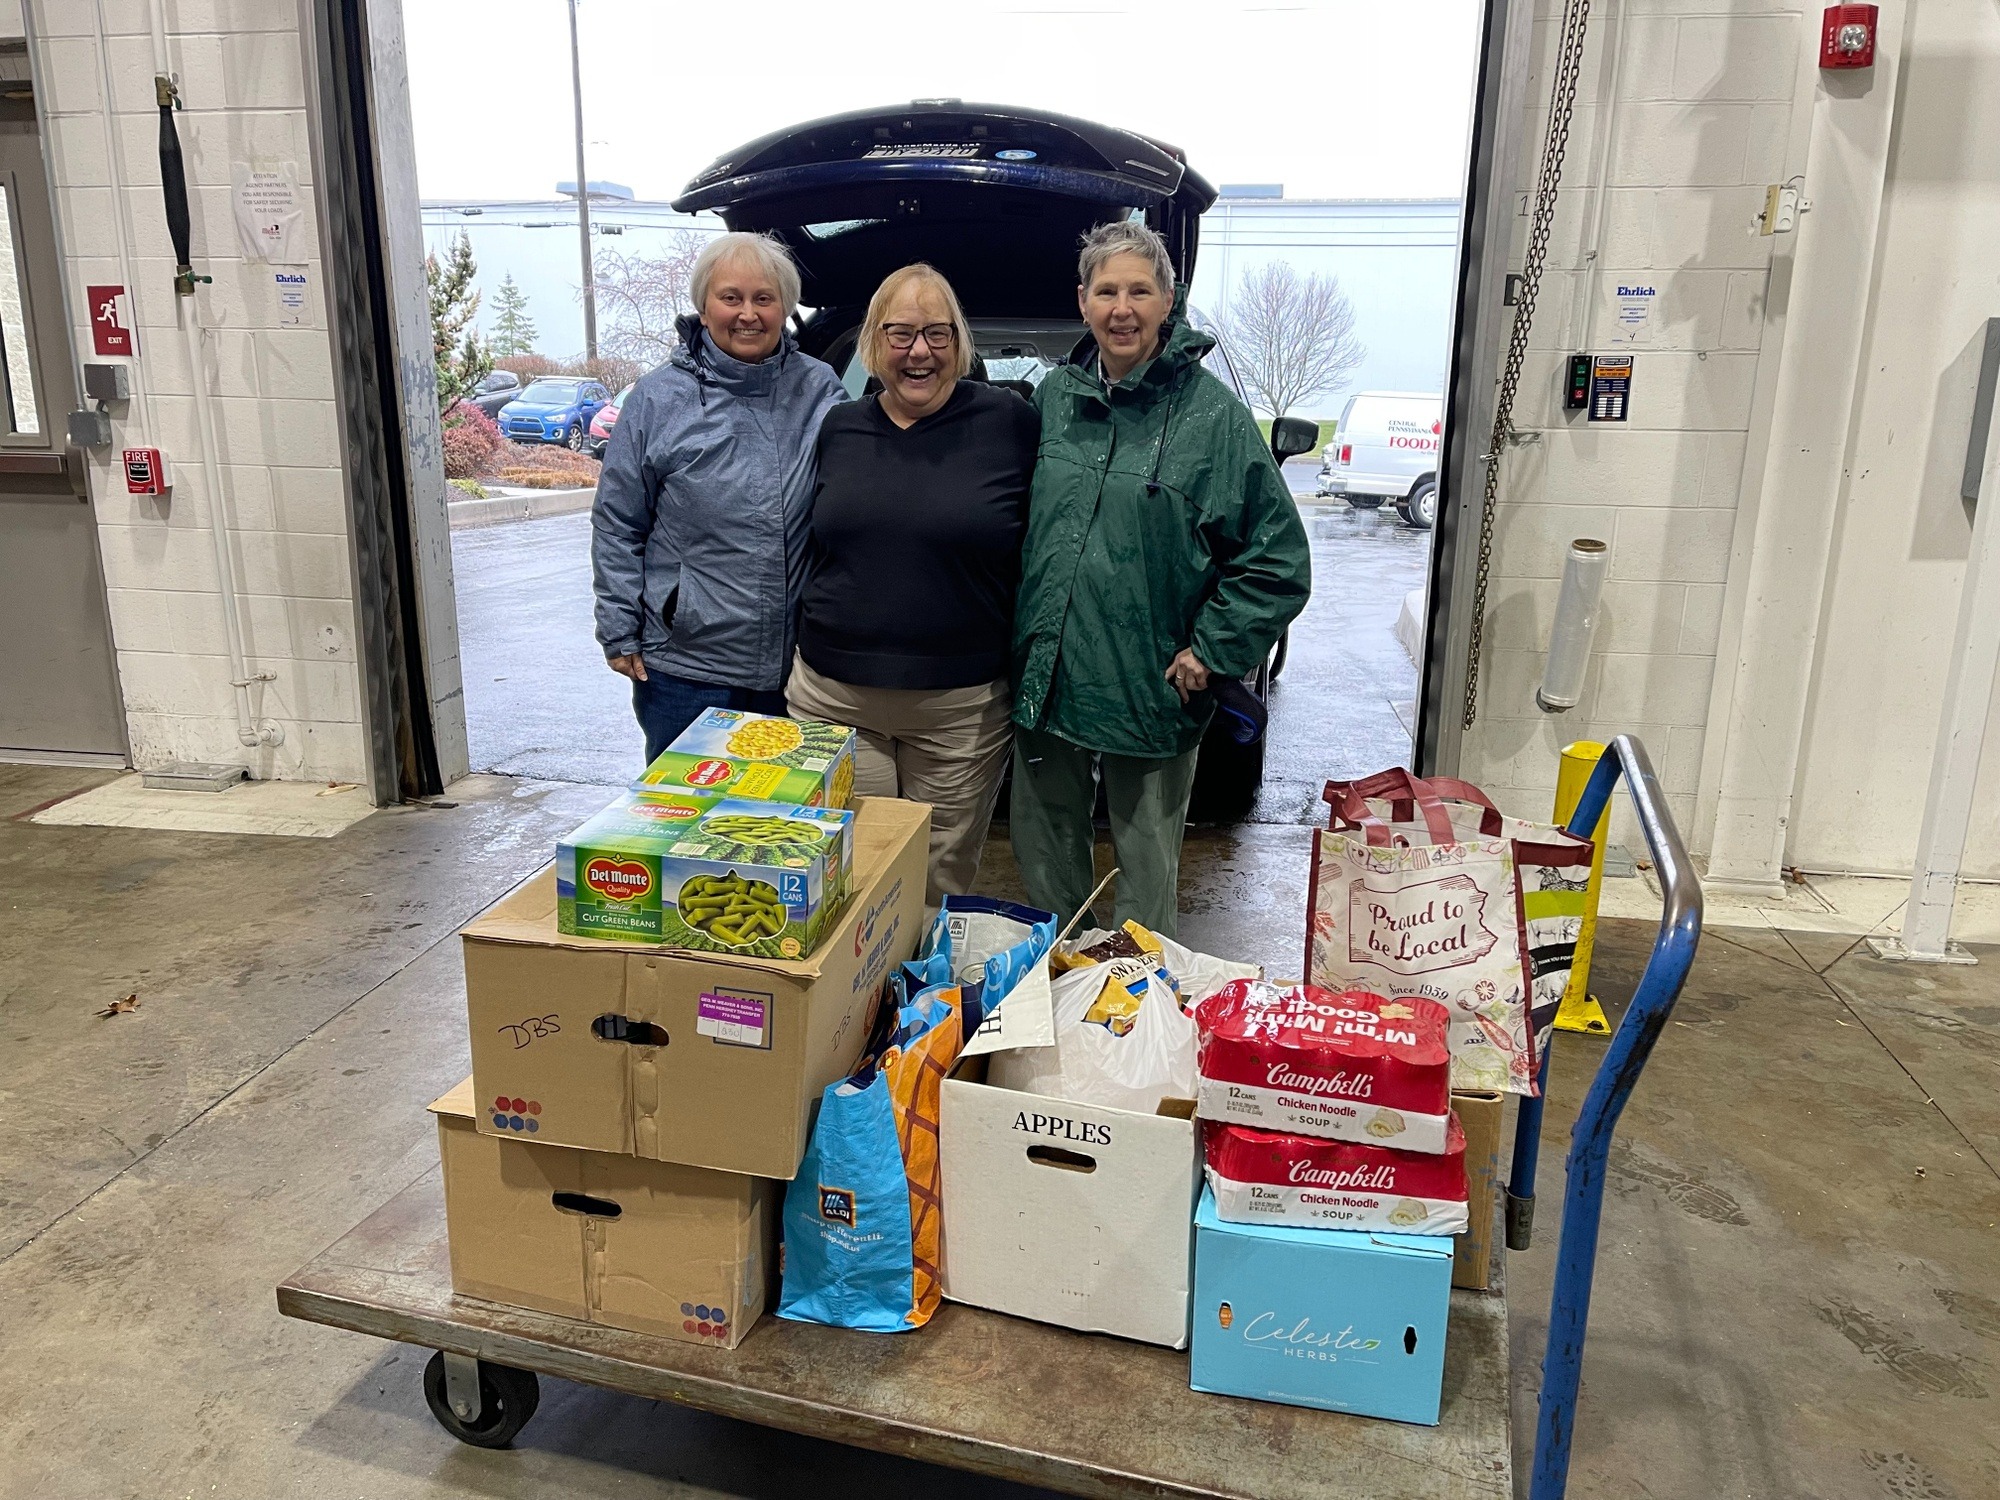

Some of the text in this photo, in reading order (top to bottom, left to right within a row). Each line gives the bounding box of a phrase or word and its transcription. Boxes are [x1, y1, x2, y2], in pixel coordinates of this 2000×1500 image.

[276, 274, 306, 283] Ehrlich
[1617, 287, 1655, 296] Ehrlich
[1390, 436, 1430, 450] FOOD
[125, 452, 149, 461] FIRE
[654, 806, 696, 816] Monte
[644, 827, 680, 836] BEANS
[590, 868, 648, 886] Del Monte
[784, 875, 801, 892] 12
[607, 884, 630, 895] Quality
[782, 892, 803, 902] CANS
[582, 913, 656, 928] CUT GREEN BEANS
[1369, 901, 1464, 931] Proud to
[1369, 925, 1468, 962] be Local
[1538, 957, 1550, 966] THANK
[1389, 983, 1449, 1000] Since 1959
[498, 1014, 561, 1049] DBS
[1334, 1021, 1417, 1046] M'm!
[1266, 1063, 1373, 1098] Campbell's
[1228, 1087, 1240, 1098] 12
[1278, 1096, 1317, 1111] Chicken
[1319, 1103, 1357, 1117] Noodle
[1011, 1111, 1112, 1145] APPLES
[1299, 1116, 1330, 1127] SOUP
[1288, 1159, 1395, 1190] Campbell's
[1251, 1187, 1263, 1198] 12
[1300, 1193, 1379, 1209] Chicken Noodle
[826, 1209, 850, 1219] ALDI
[1322, 1210, 1353, 1220] SOUP
[1244, 1311, 1370, 1350] Celeste
[1285, 1347, 1337, 1362] HERBS
